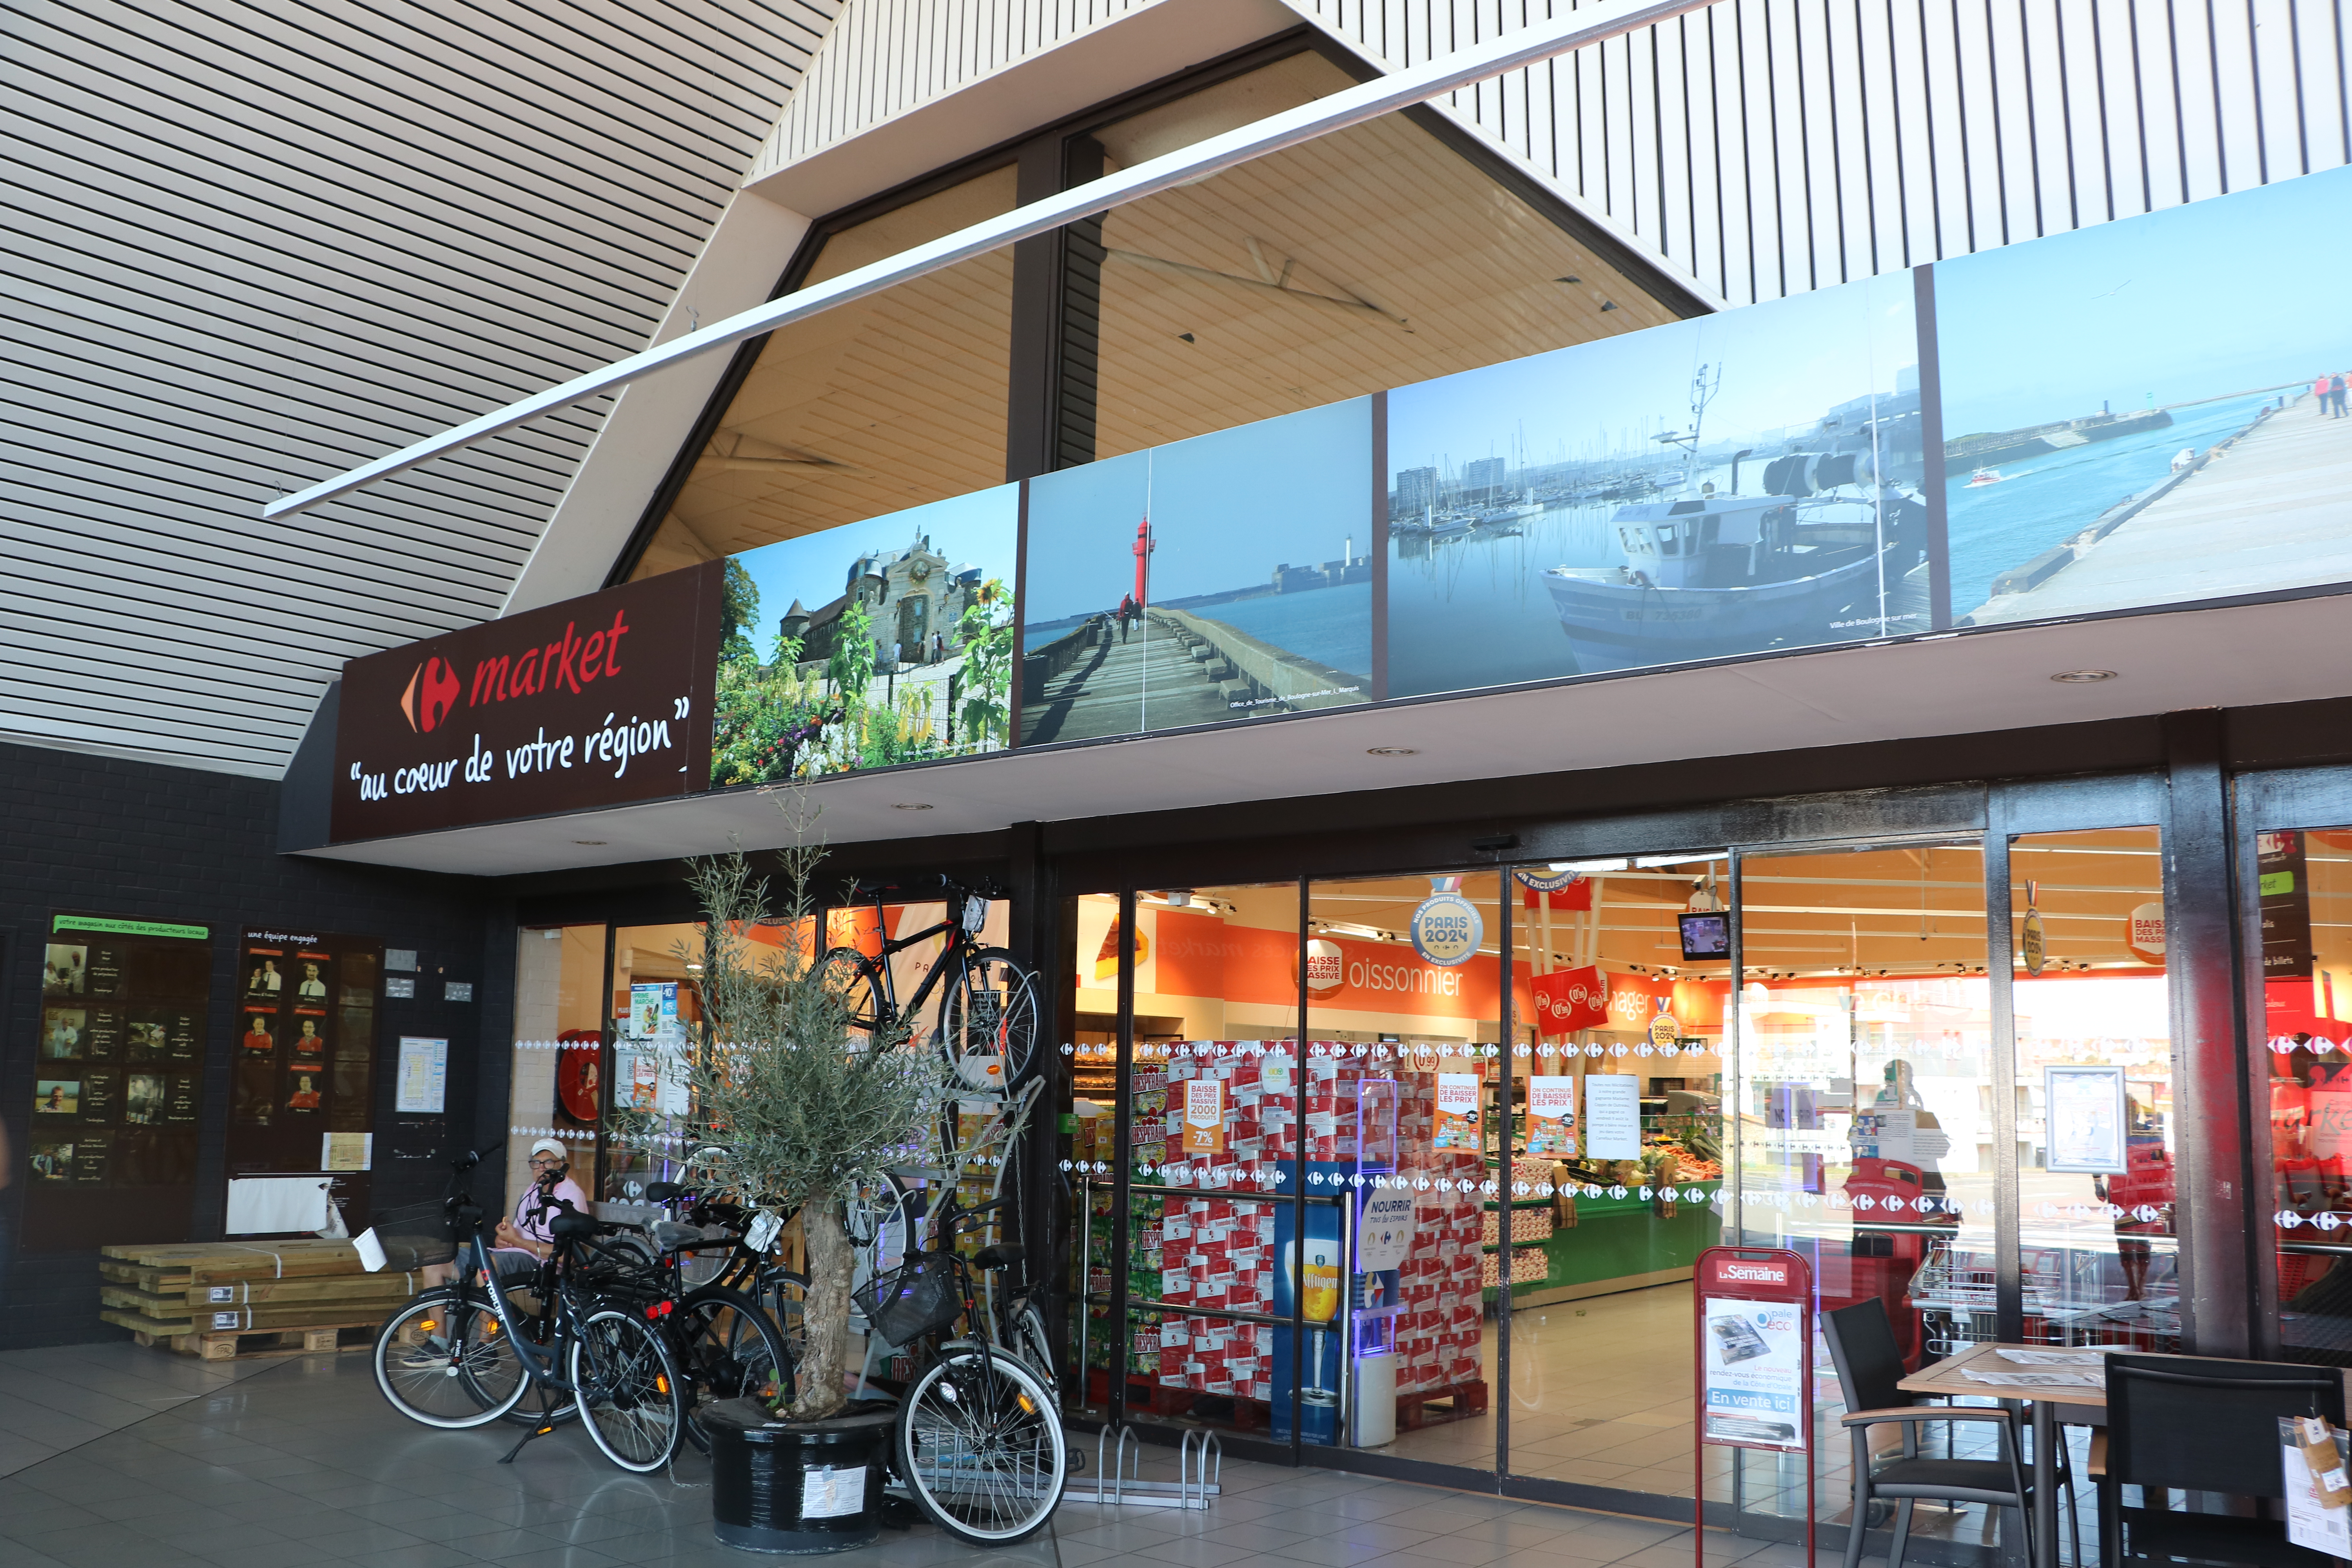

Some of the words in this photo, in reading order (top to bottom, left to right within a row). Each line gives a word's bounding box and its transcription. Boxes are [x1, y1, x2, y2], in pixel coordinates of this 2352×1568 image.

[470, 610, 629, 707] market
[465, 733, 492, 783] de
[506, 726, 574, 779] votre
[1528, 871, 1580, 890] EXCLUSIVIT
[1413, 910, 1423, 923] NOS
[1422, 897, 1454, 910] PRODUITS
[1455, 898, 1479, 924] OFFICIELS
[1425, 917, 1467, 928] PARIS
[148, 926, 185, 934] producteurs
[1426, 929, 1467, 942] 2024
[264, 931, 287, 942] équipe
[290, 935, 318, 945] engagée
[1308, 956, 1339, 965] AISSE
[1421, 951, 1431, 960] EN
[1349, 959, 1463, 996] oissonnier
[1191, 1105, 1216, 1114] 2000
[1132, 1125, 1166, 1145] DESPERADO
[1193, 1131, 1213, 1143] -7%
[1371, 1200, 1411, 1213] NOURRIR
[1728, 1265, 1784, 1281] Semaine
[486, 1281, 505, 1321] TOPLIFE
[1134, 1334, 1161, 1353] DESPERA
[1751, 1372, 1792, 1382] économique
[1767, 1381, 1792, 1390] d'Opale
[1712, 1391, 1729, 1404] En
[1732, 1394, 1771, 1408] vente
[1775, 1396, 1790, 1410] ici
